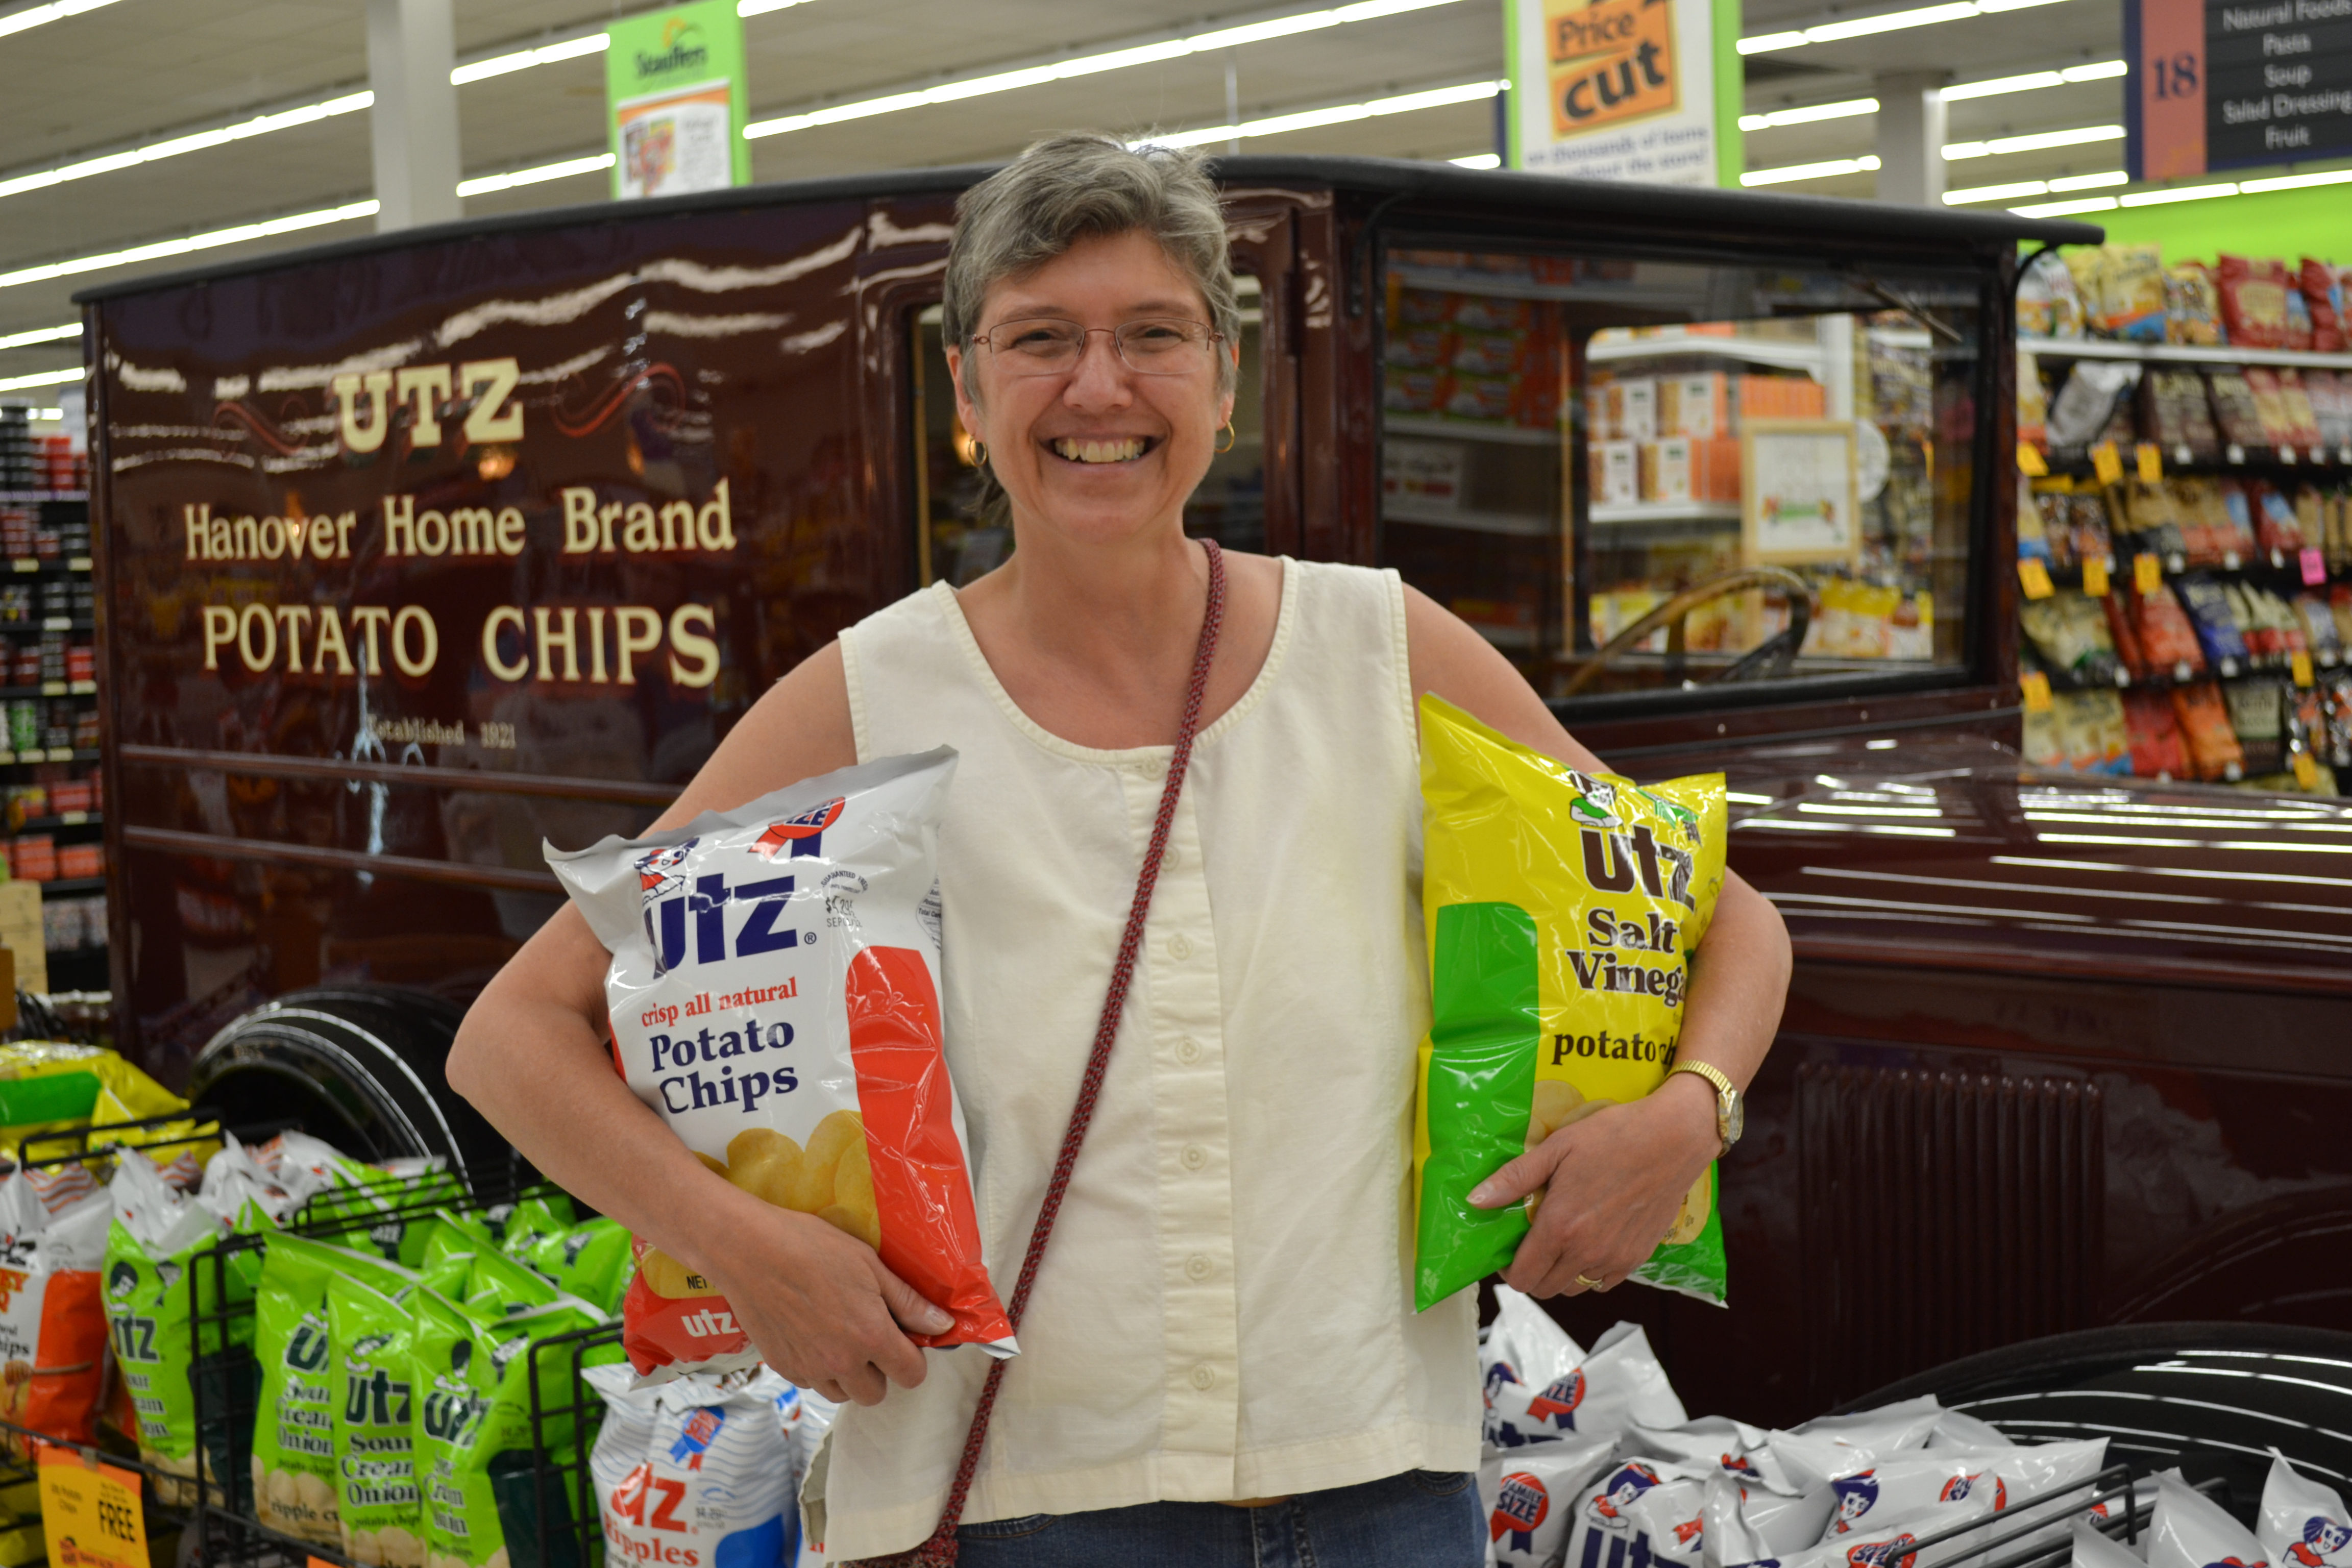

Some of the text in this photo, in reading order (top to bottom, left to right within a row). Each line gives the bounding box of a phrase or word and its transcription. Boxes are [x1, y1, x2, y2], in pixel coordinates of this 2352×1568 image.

[1557, 10, 1635, 50] Price
[2223, 1, 2292, 31] Natural
[1564, 41, 1665, 119] cut
[2153, 52, 2198, 99] 18
[2264, 64, 2313, 88] Soup
[2223, 96, 2270, 124] Salad
[2265, 125, 2311, 150] Fruit
[333, 358, 524, 453] UTZ
[184, 478, 737, 560] Hanover Home Brand
[204, 604, 720, 689] POTATO CHIPS
[365, 714, 517, 749] Established 1921
[821, 870, 856, 888] GUARANTEED
[1580, 823, 1697, 912] utz
[643, 872, 798, 980] utz
[1587, 909, 1676, 953] Salt
[641, 976, 798, 1028] crisp all natural
[1567, 951, 1685, 1008] Vineg
[650, 1018, 795, 1073] Potato
[1552, 1030, 1656, 1066] potato
[659, 1065, 799, 1115] Chips
[681, 1308, 740, 1337] utz
[97, 1500, 135, 1545] FREE
[271, 1499, 317, 1523] ripple
[1497, 1491, 1538, 1526] SIZE
[604, 1510, 700, 1566] Ripples
